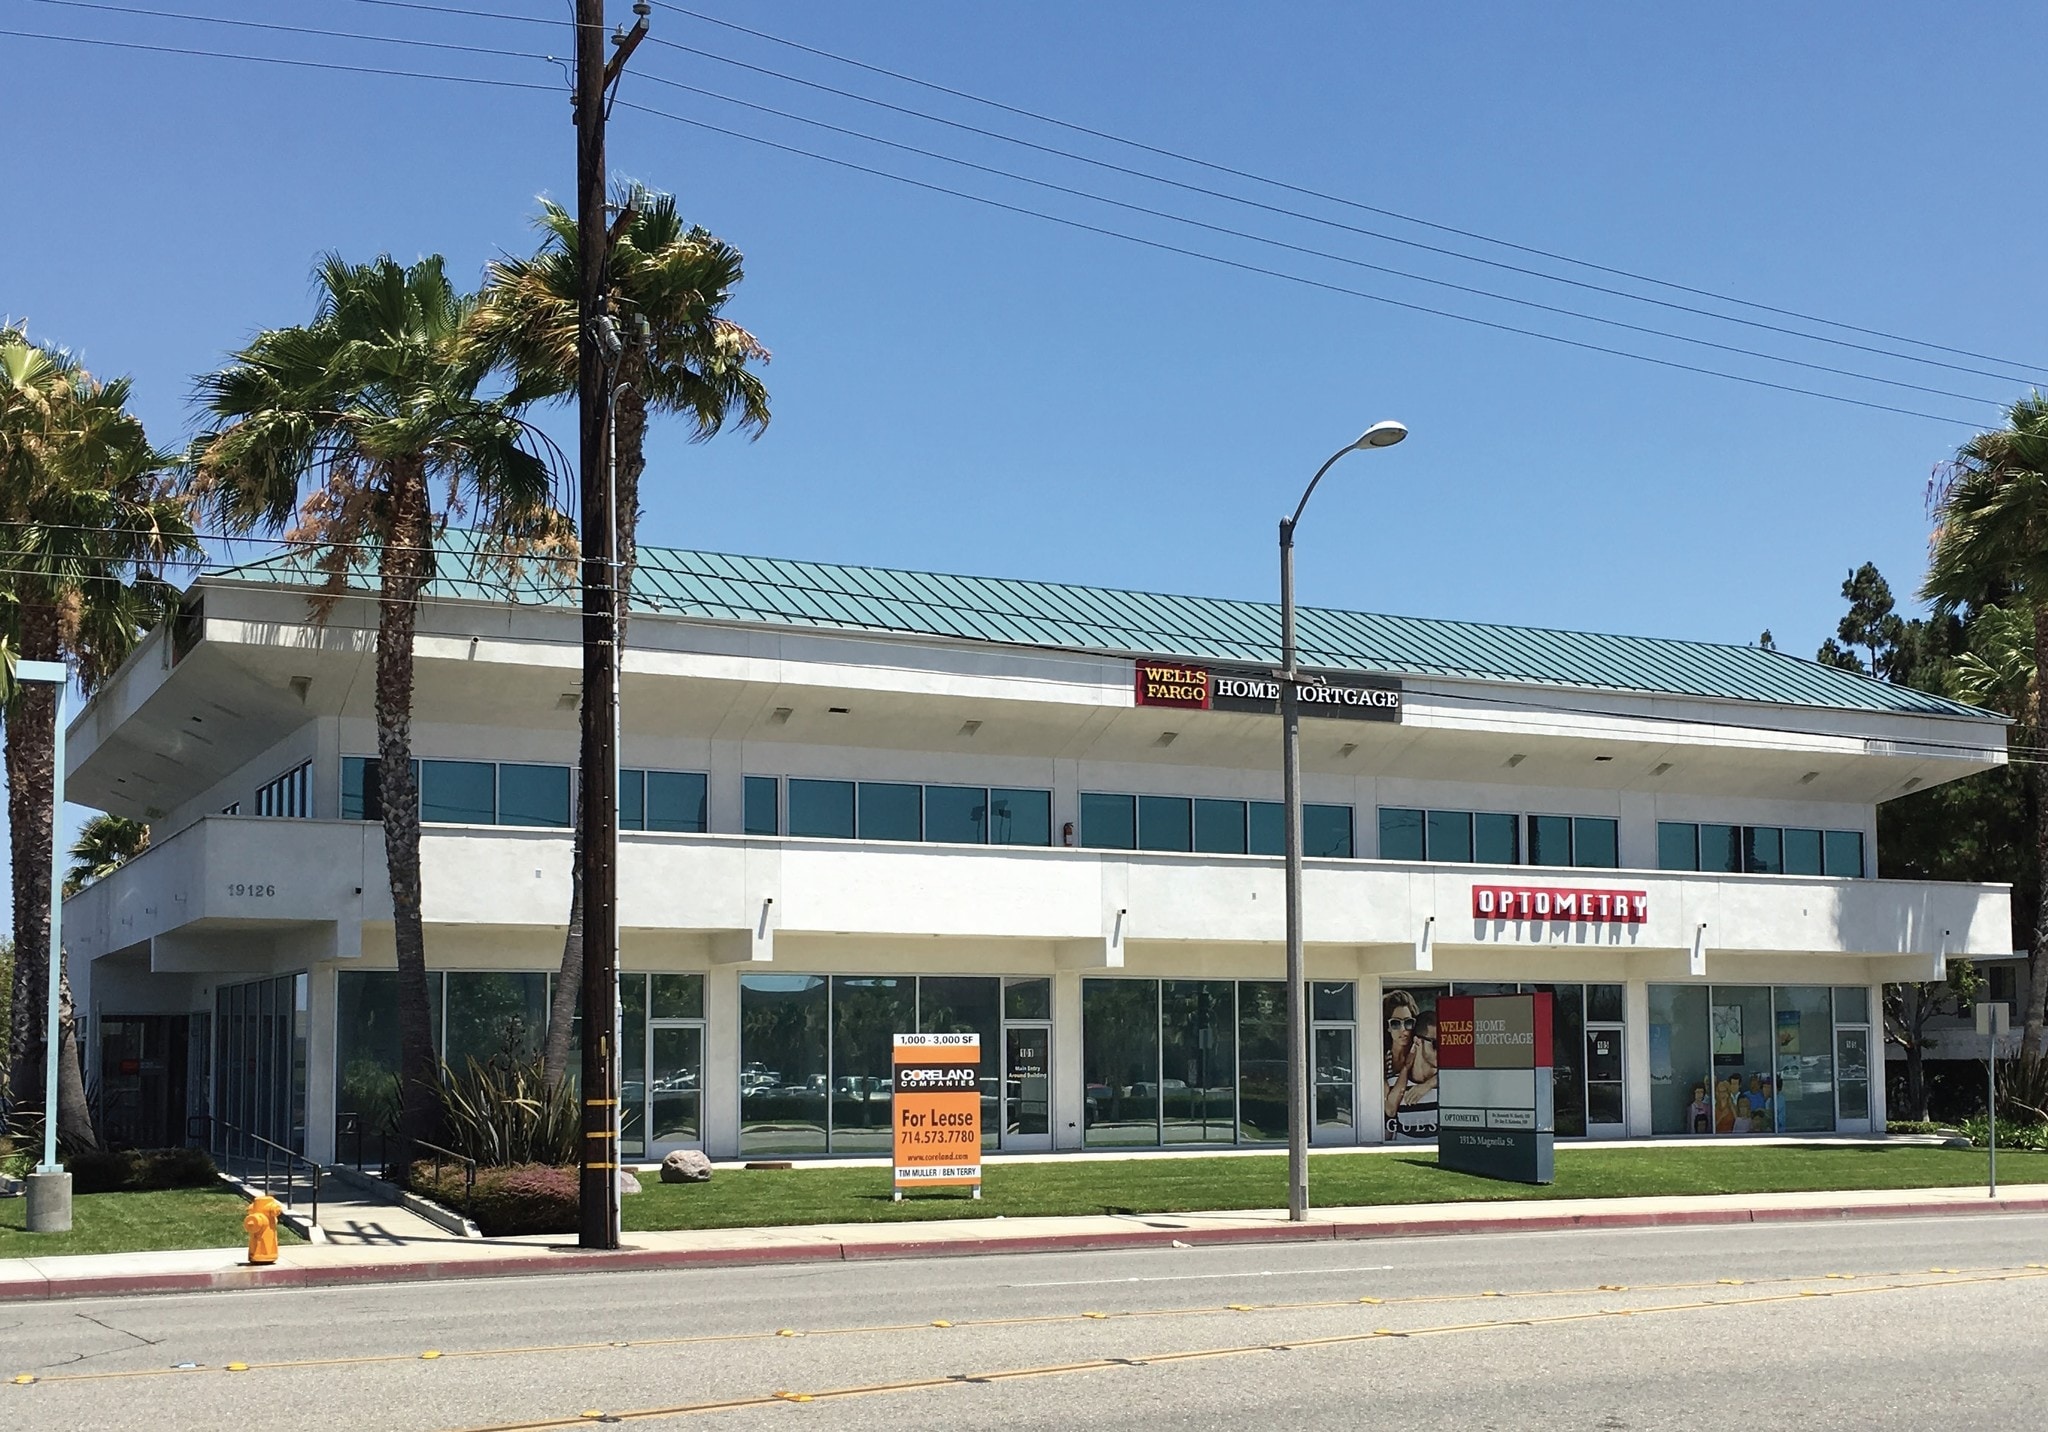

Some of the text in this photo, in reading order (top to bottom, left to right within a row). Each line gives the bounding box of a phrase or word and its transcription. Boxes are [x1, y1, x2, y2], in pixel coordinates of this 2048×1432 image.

[1145, 667, 1206, 684] WELLS
[1147, 684, 1206, 700] FARGO
[1217, 680, 1280, 699] HOME
[228, 884, 275, 897] 19126
[1479, 890, 1647, 917] OPTOMETRY
[1440, 1021, 1473, 1032] WELLS
[1476, 1020, 1506, 1031] HOME
[901, 1036, 926, 1044] 1,000
[933, 1036, 960, 1044] 3,000
[1441, 1033, 1473, 1045] FARGO
[1476, 1033, 1534, 1045] MORTGAGE
[901, 1069, 975, 1080] CORELAND
[902, 1109, 973, 1127] For Lease
[1445, 1114, 1480, 1122] OPTOMETRY
[901, 1130, 975, 1144] 714.573.7780
[1459, 1136, 1477, 1145] 19126
[1476, 1136, 1506, 1148] Magnolia
[907, 1152, 969, 1161] www.coreland.com
[899, 1169, 911, 1177] TIM
[912, 1168, 937, 1177] MULLER
[943, 1168, 955, 1176] BEN
[957, 1167, 976, 1175] TERRY
